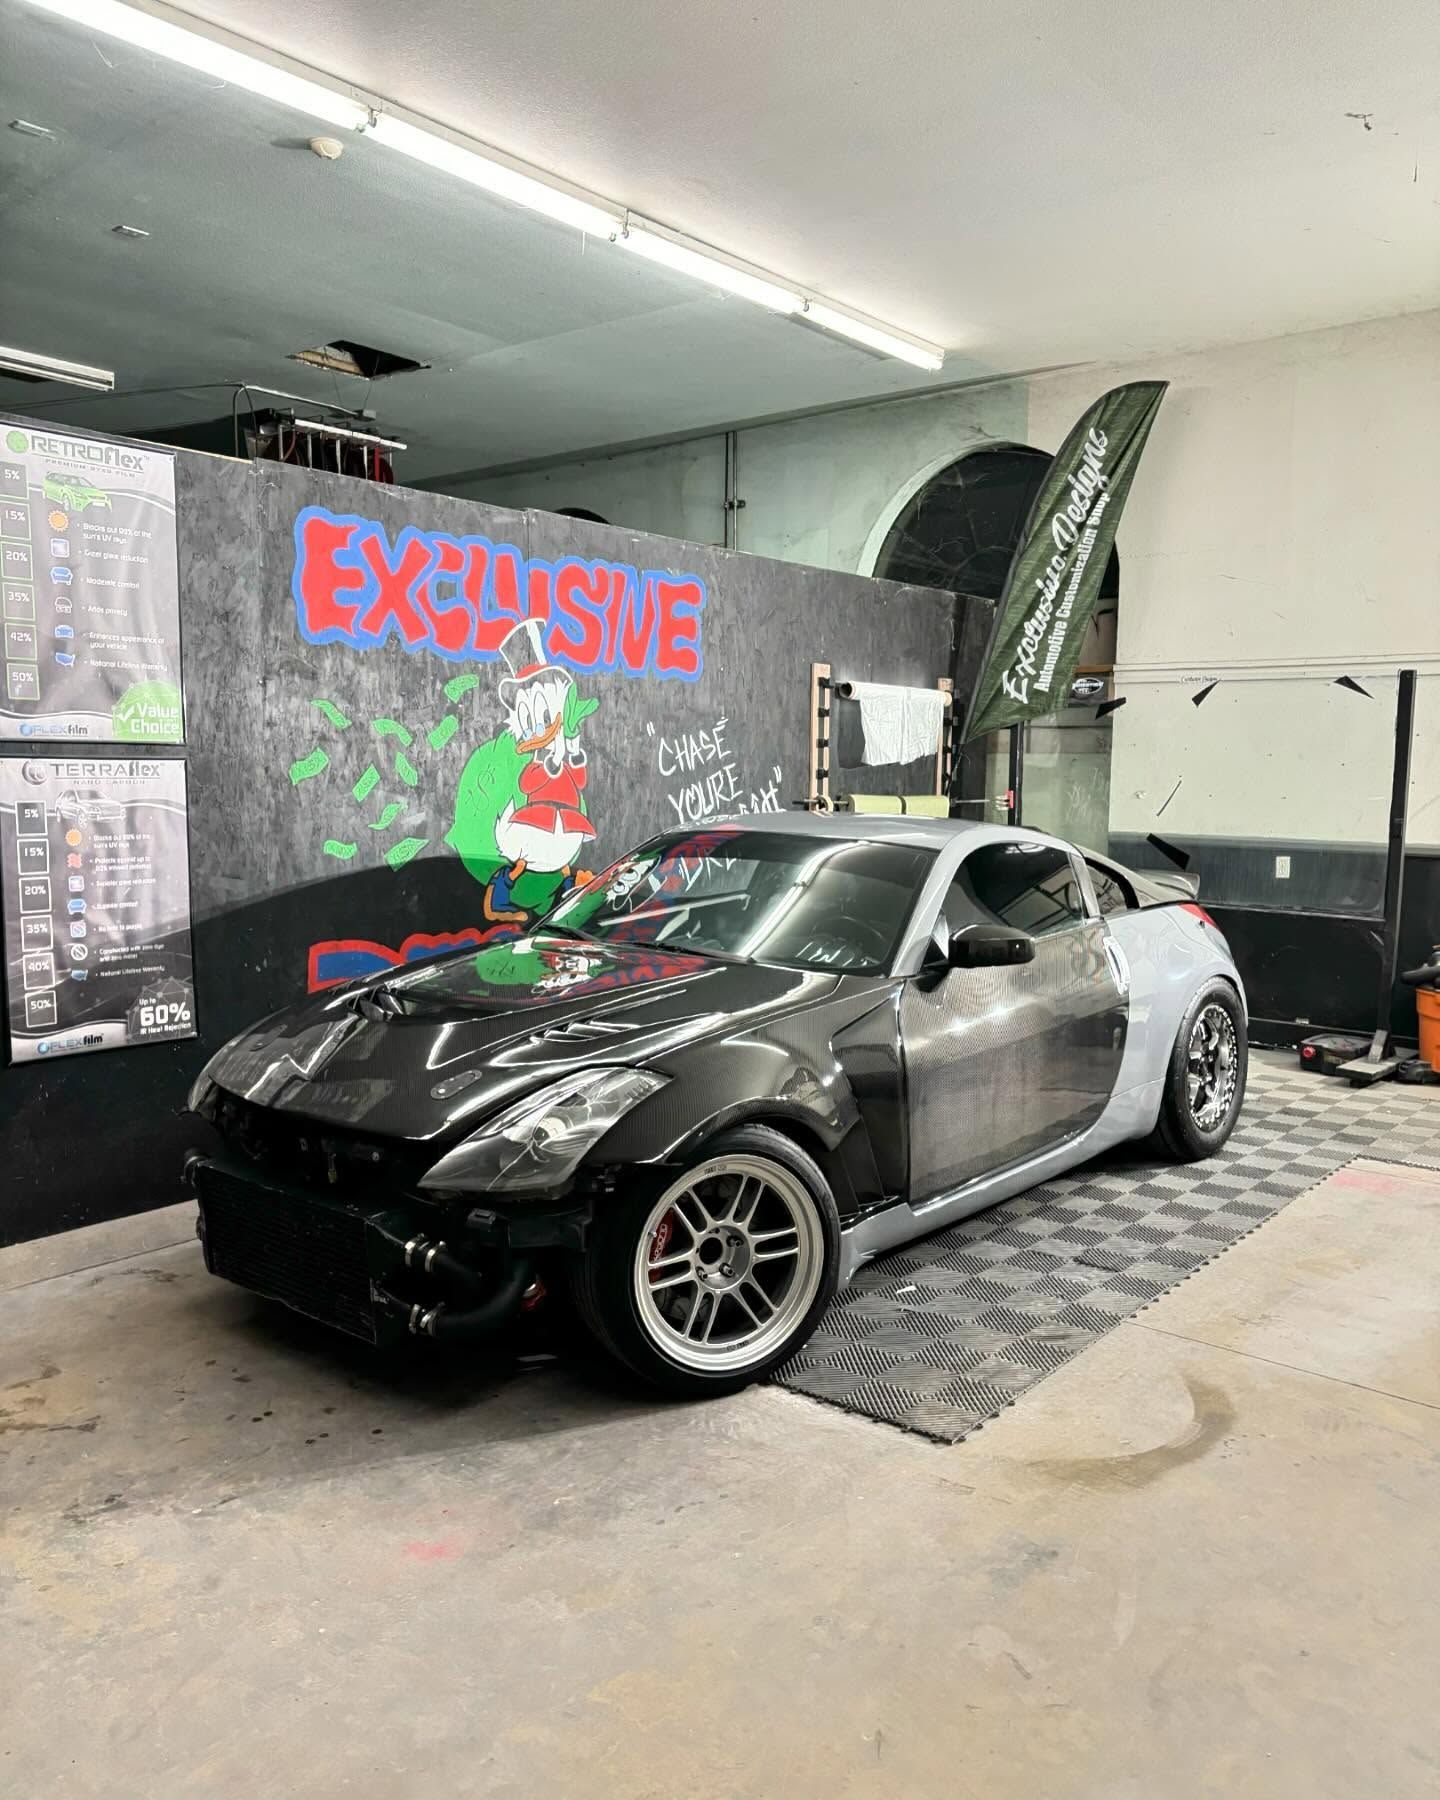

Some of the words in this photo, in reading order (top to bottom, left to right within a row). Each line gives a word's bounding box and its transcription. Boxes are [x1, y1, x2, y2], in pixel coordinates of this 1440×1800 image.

[4, 469, 20, 480] 5%
[1052, 427, 1109, 552] Designs
[5, 510, 26, 521] 15%
[6, 551, 28, 562] 20%
[8, 592, 30, 602] 35%
[294, 507, 706, 681] EXCLUSIVE
[1033, 617, 1068, 693] Automotive
[1055, 529, 1098, 619] Customization
[12, 672, 34, 682] 50%
[136, 703, 178, 718] Value
[131, 718, 180, 735] Choice
[24, 808, 39, 818] 5%
[24, 847, 44, 857] 15%
[24, 885, 46, 896] 20%
[26, 924, 48, 934] 35%
[28, 961, 50, 971] 40%
[30, 999, 52, 1010] 50%
[140, 1001, 191, 1027] 60%
